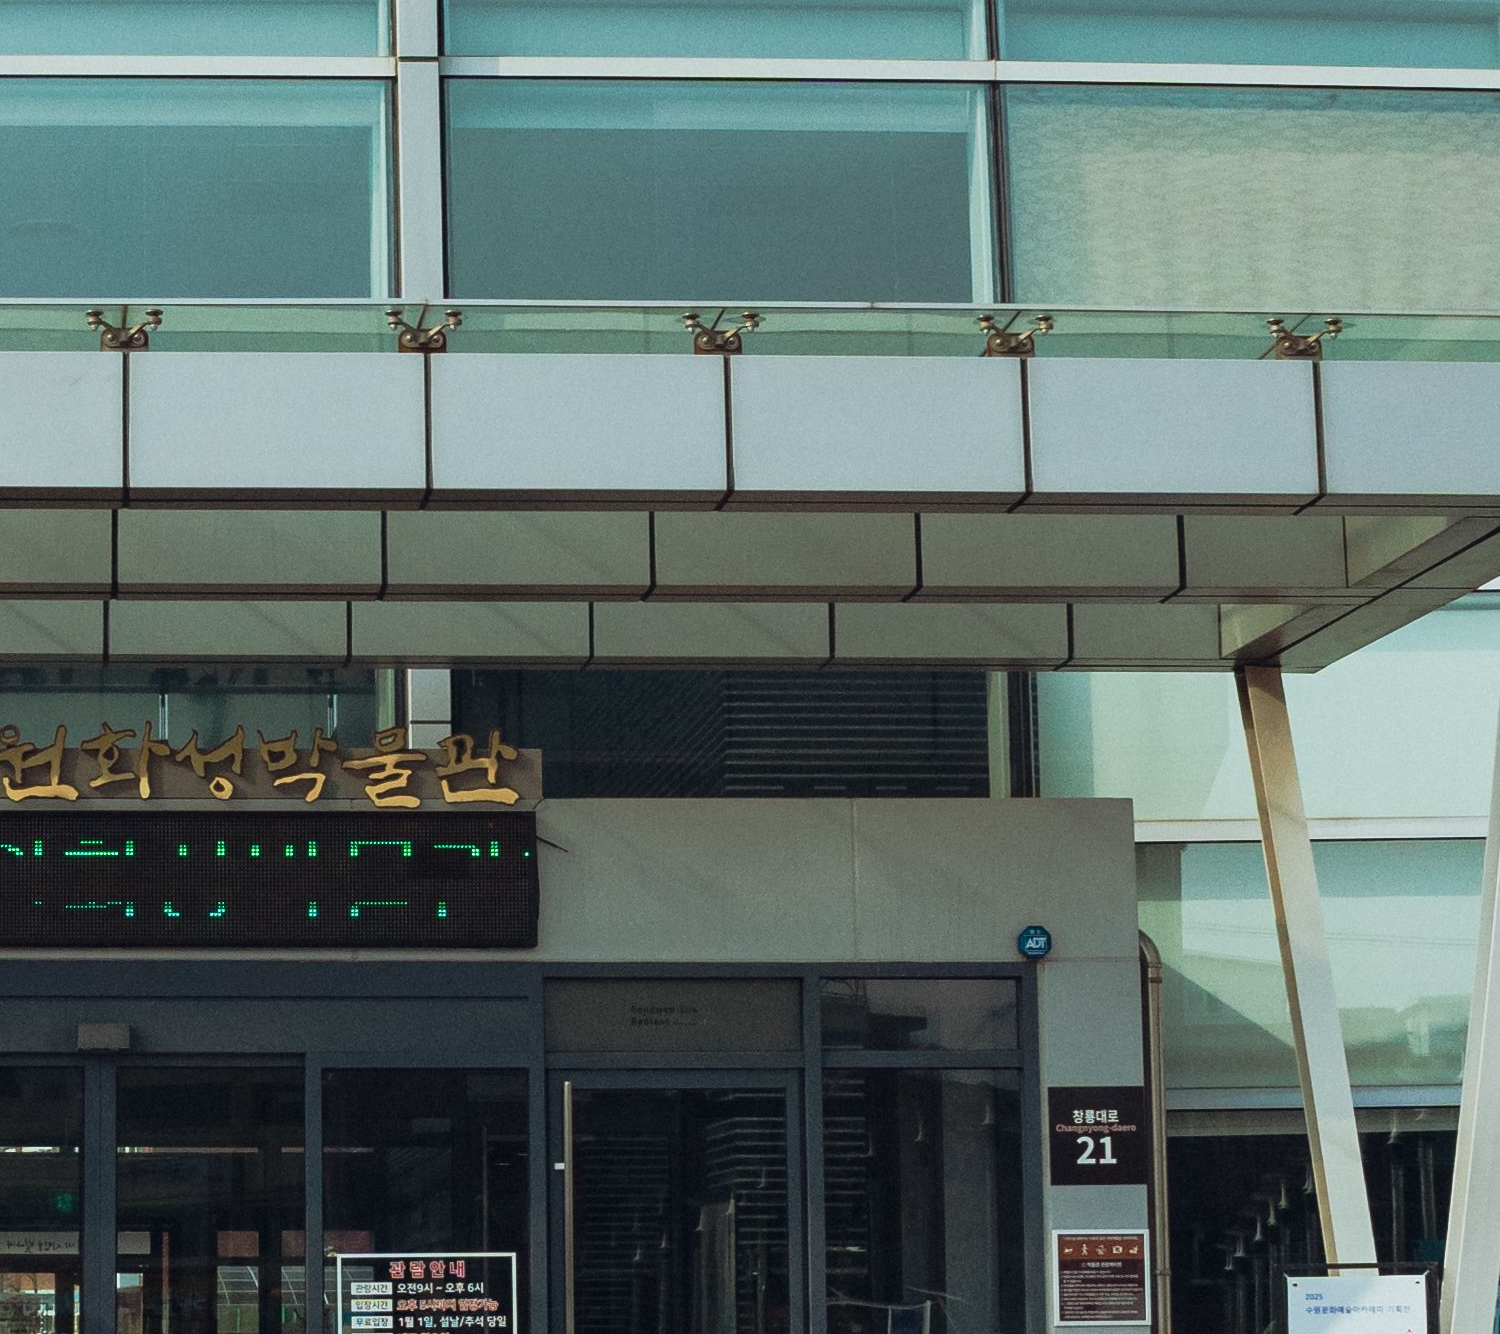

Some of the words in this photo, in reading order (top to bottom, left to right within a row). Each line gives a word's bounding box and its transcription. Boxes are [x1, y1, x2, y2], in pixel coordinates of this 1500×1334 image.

[1025, 937, 1047, 949] ADT
[1072, 1109, 1119, 1124] 창룡대로
[1055, 1124, 1137, 1134] Changnyong-daero
[1076, 1136, 1117, 1164] 21
[355, 1284, 388, 1293] 관람시간
[396, 1283, 433, 1294] 오전9시
[444, 1283, 465, 1294] 오후
[467, 1283, 484, 1294] 6시
[1305, 1293, 1323, 1301] 2025
[355, 1301, 388, 1310] 입장시간
[1305, 1306, 1384, 1314] 수원문화예술아카데미
[355, 1318, 389, 1327] 무료입장
[398, 1316, 414, 1328] 1월
[440, 1315, 484, 1328] 설날/추석
[486, 1316, 507, 1327] 당일
